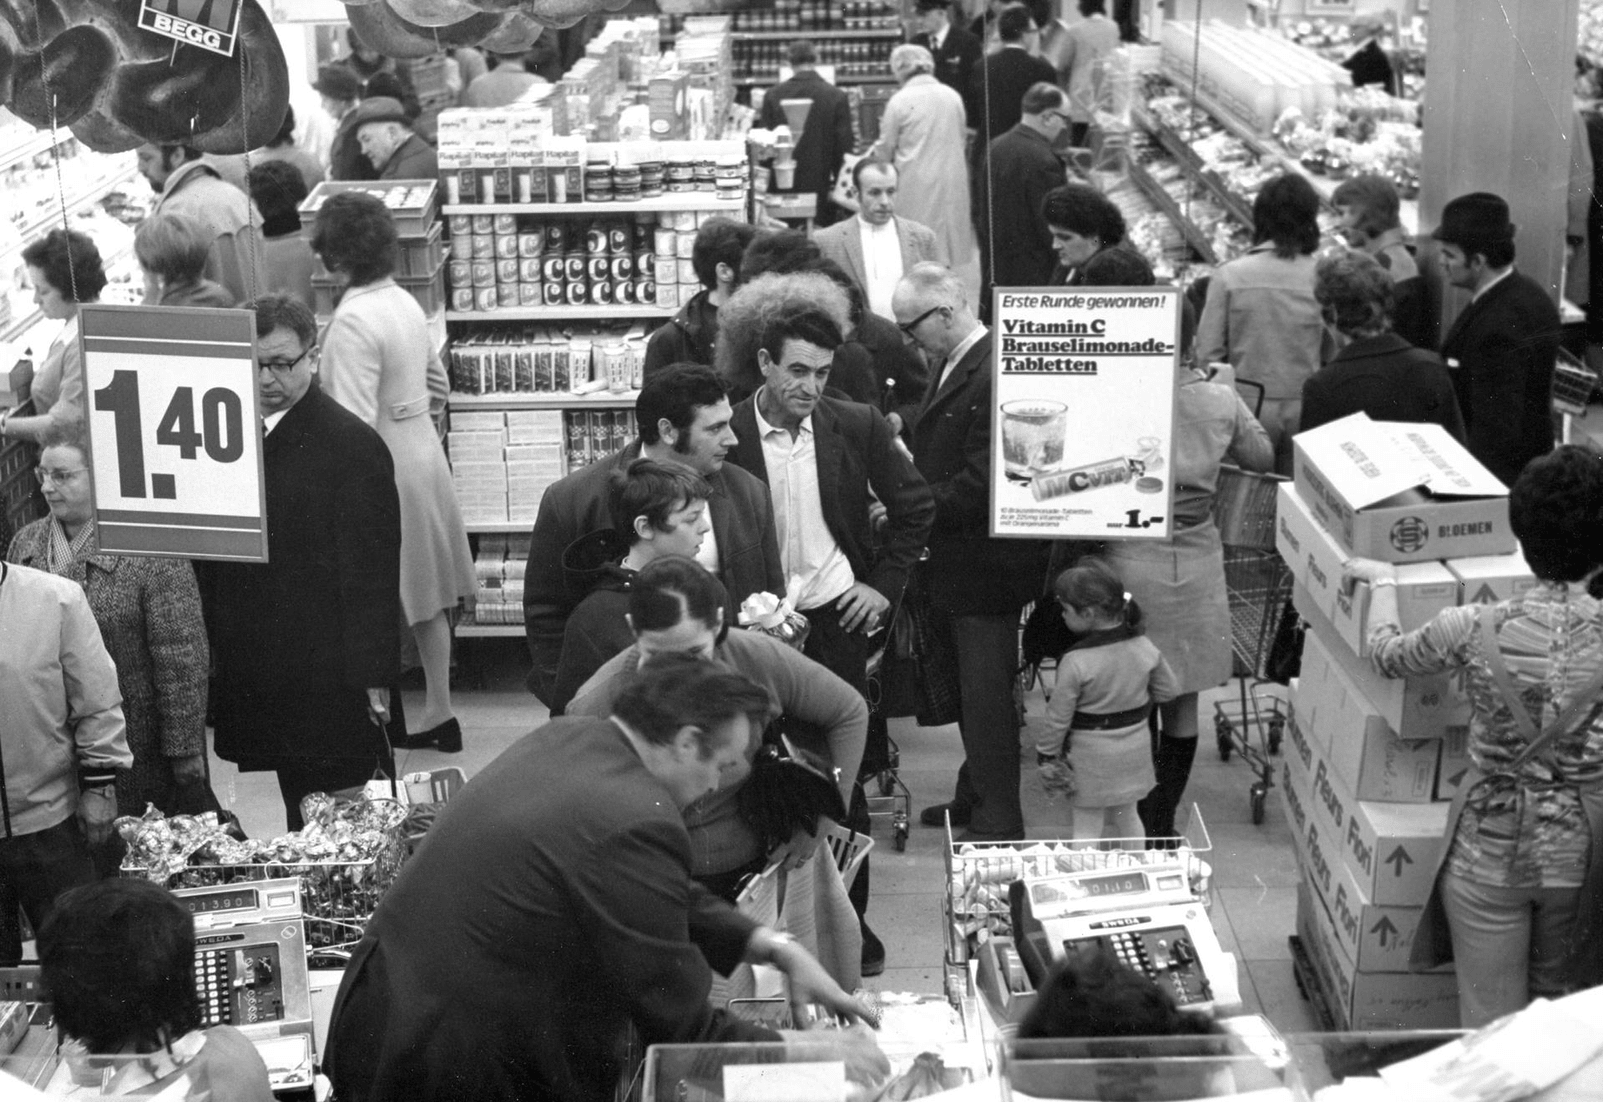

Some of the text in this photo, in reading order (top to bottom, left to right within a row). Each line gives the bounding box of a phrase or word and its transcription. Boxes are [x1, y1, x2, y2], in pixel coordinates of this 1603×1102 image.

[153, 13, 221, 49] BEGG
[1002, 295, 1039, 308] Erste
[1040, 295, 1085, 308] Runde
[1002, 319, 1106, 334] Vitamin C
[1002, 338, 1175, 353] Brauselimonade-
[1002, 357, 1098, 372] Tabletten
[94, 369, 245, 500] 1.40
[1438, 521, 1493, 538] BLOEMEN
[1314, 758, 1344, 828] Fleurs
[1307, 822, 1332, 893] Fleurs
[1347, 815, 1373, 877] Fiori
[1335, 882, 1358, 945] Fiori
